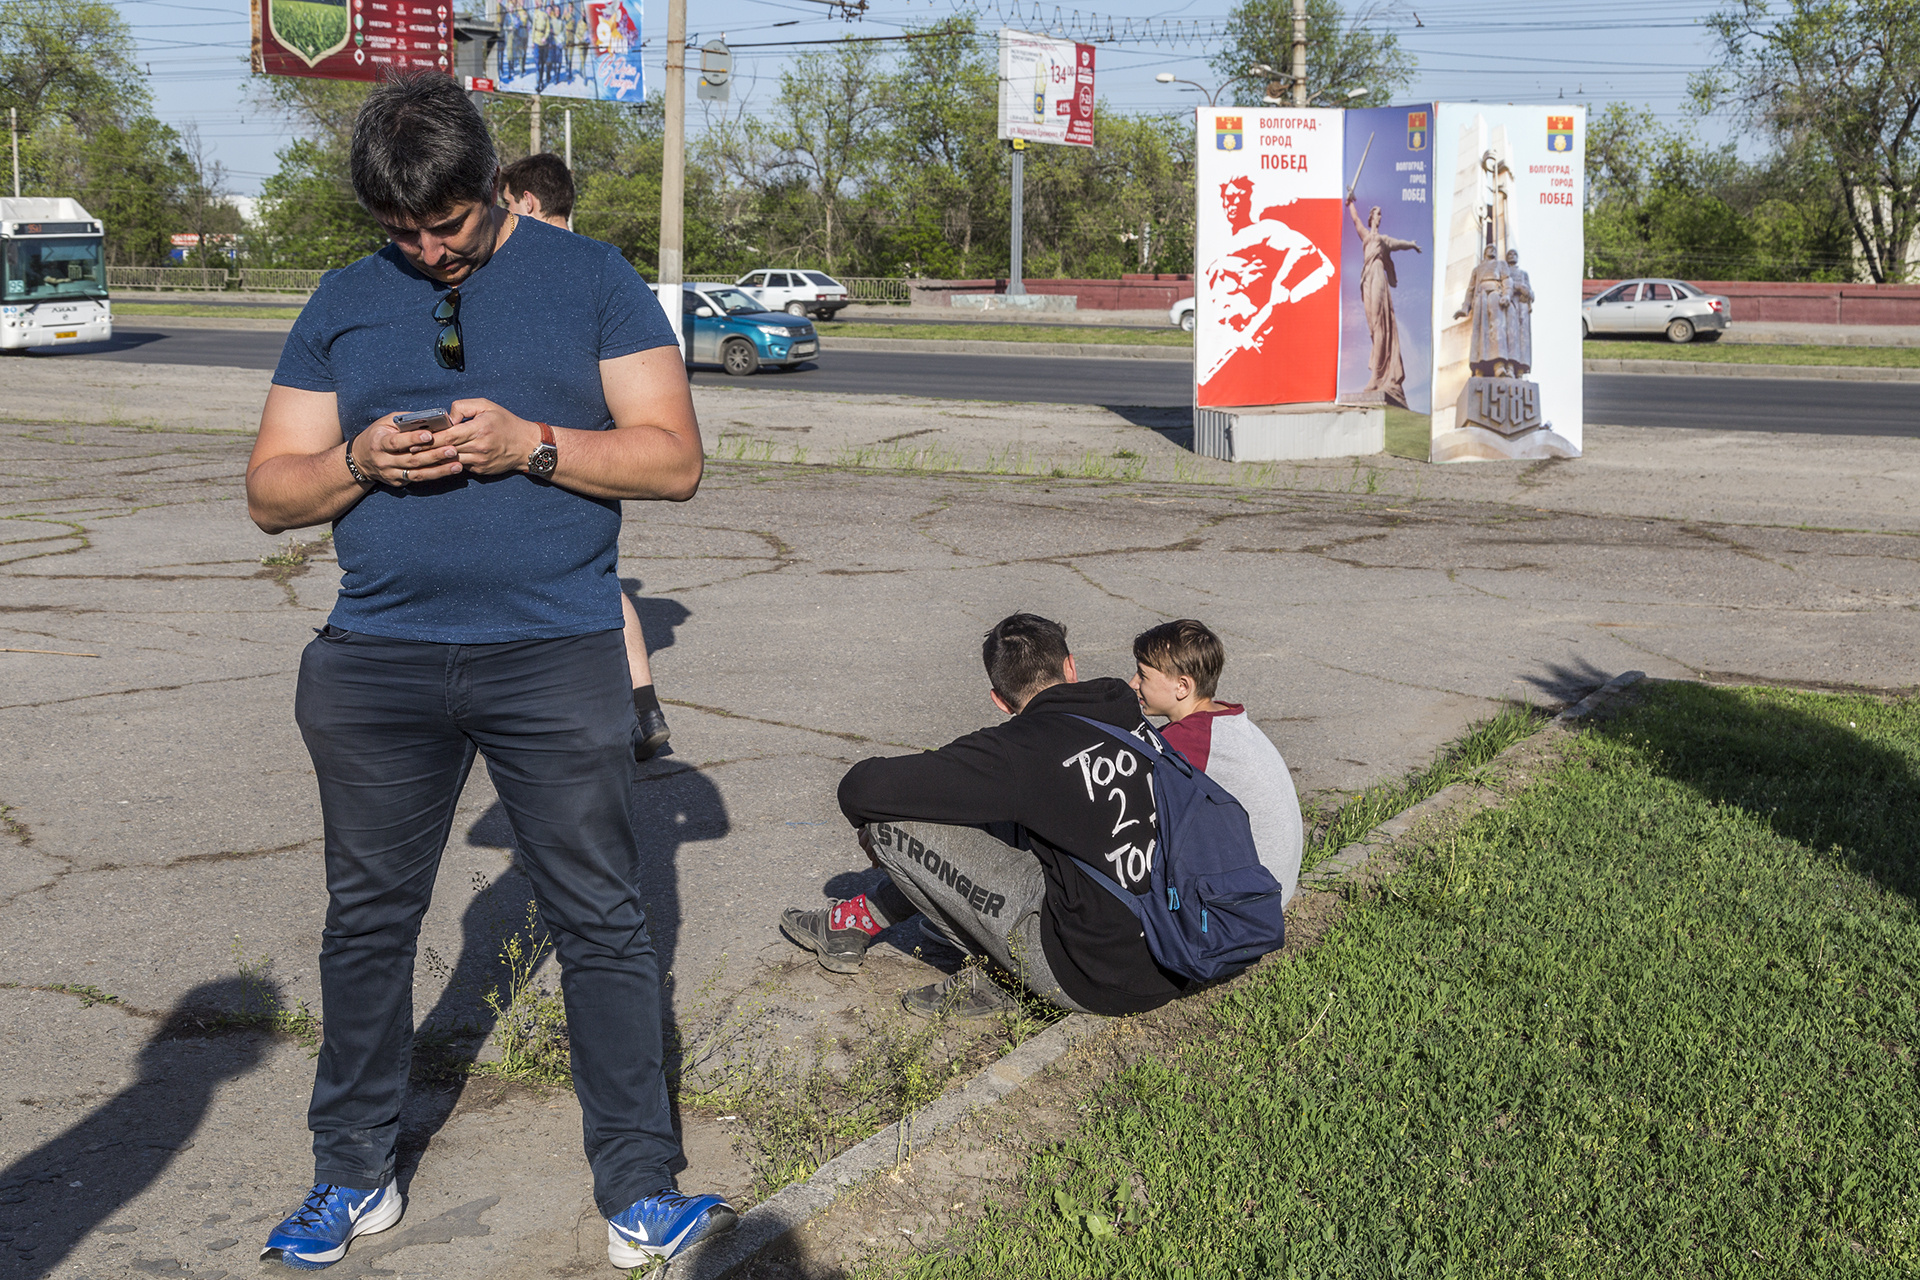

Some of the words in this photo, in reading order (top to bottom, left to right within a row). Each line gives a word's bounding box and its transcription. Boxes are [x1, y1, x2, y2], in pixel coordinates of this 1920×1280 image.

[1051, 65, 1066, 84] 134
[1260, 118, 1317, 131] ВОЛГОГРАД
[1260, 135, 1292, 148] ГОРОД
[1261, 154, 1308, 173] ПОБЕД
[1529, 165, 1570, 175] ВОЛГОГРАД
[1410, 174, 1426, 184] ГОРОД
[1551, 178, 1573, 188] ГОРОД
[1402, 188, 1426, 203] ПОБЕД
[1540, 192, 1573, 207] ПОБЕД
[9, 281, 23, 292] 95
[1108, 788, 1140, 838] 2
[877, 823, 1006, 918] STRONGER
